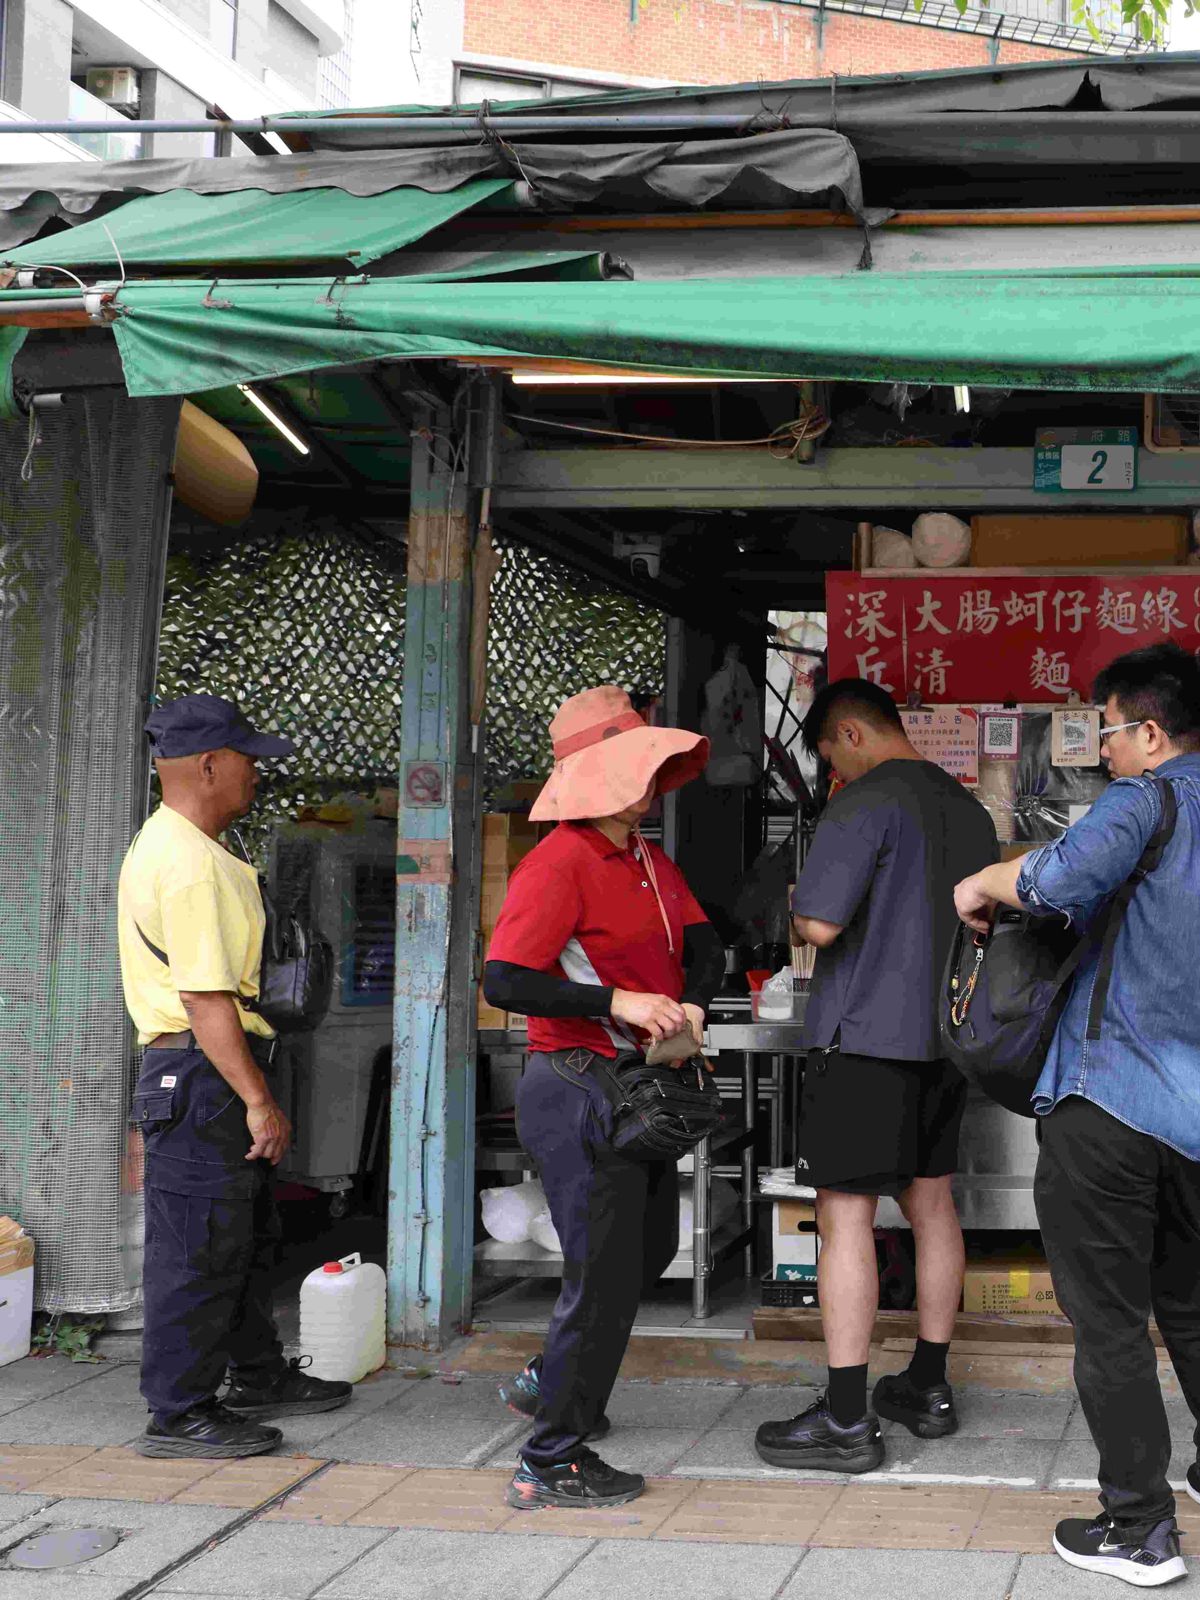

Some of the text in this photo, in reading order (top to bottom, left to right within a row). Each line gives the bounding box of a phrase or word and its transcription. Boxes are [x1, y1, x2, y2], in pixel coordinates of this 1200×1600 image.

[1087, 450, 1108, 484] 2
[913, 586, 1189, 636] 大腸蚵仔麵線
